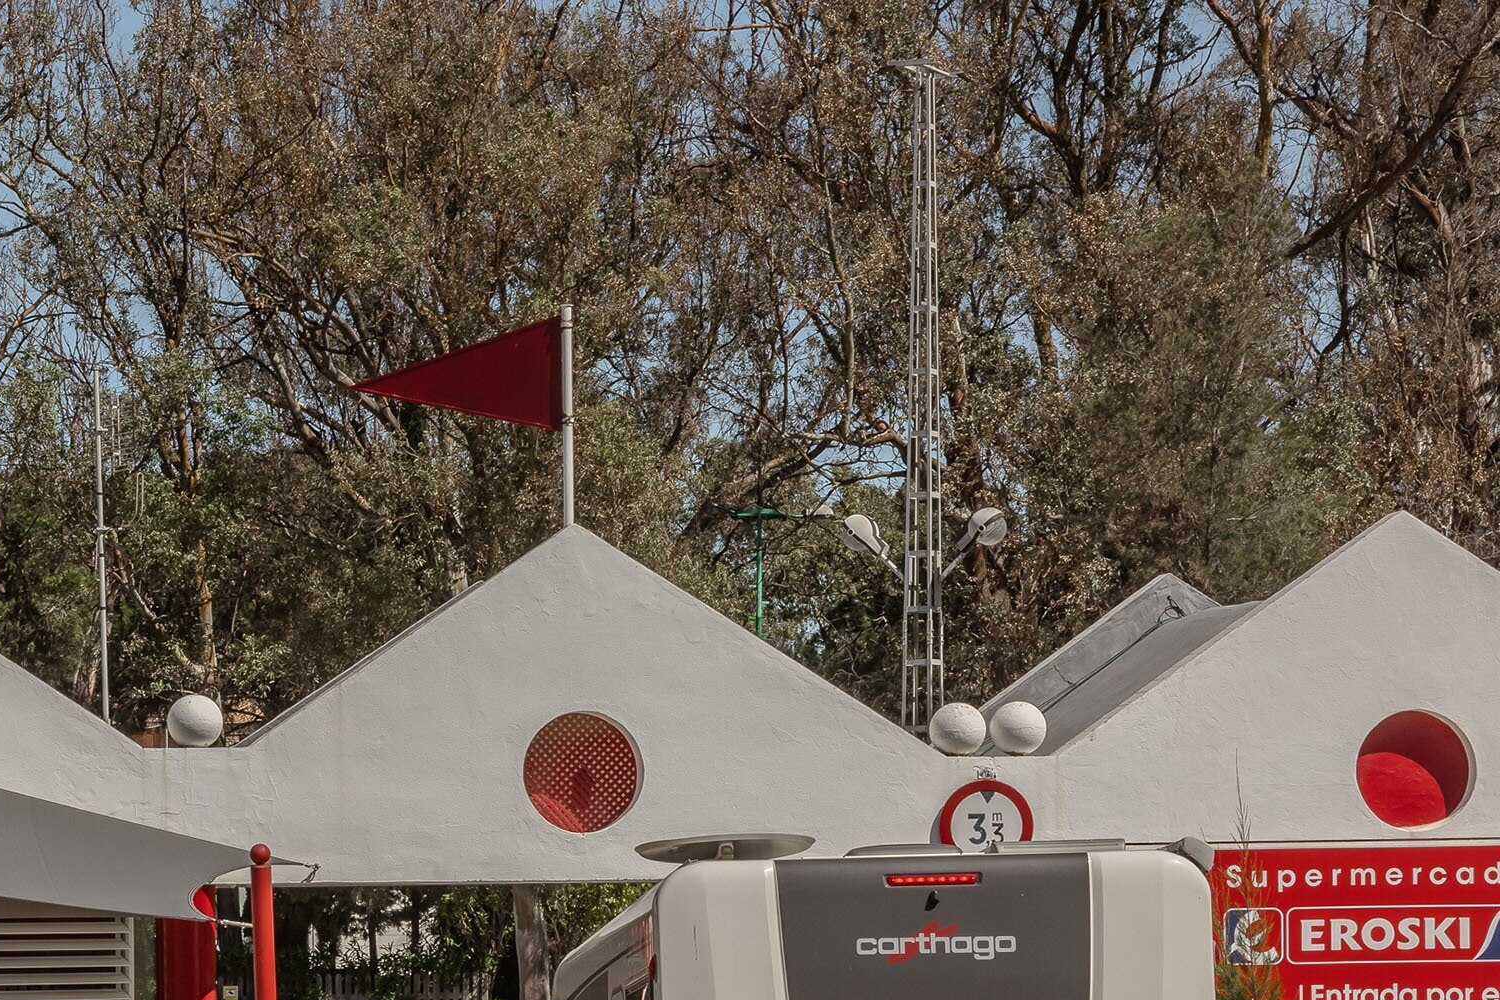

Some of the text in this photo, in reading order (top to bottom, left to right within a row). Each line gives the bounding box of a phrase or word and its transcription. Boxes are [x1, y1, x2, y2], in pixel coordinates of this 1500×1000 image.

[1226, 862, 1500, 893] Supermercad
[856, 932, 1016, 960] carthago
[1300, 917, 1471, 951] EROSKI
